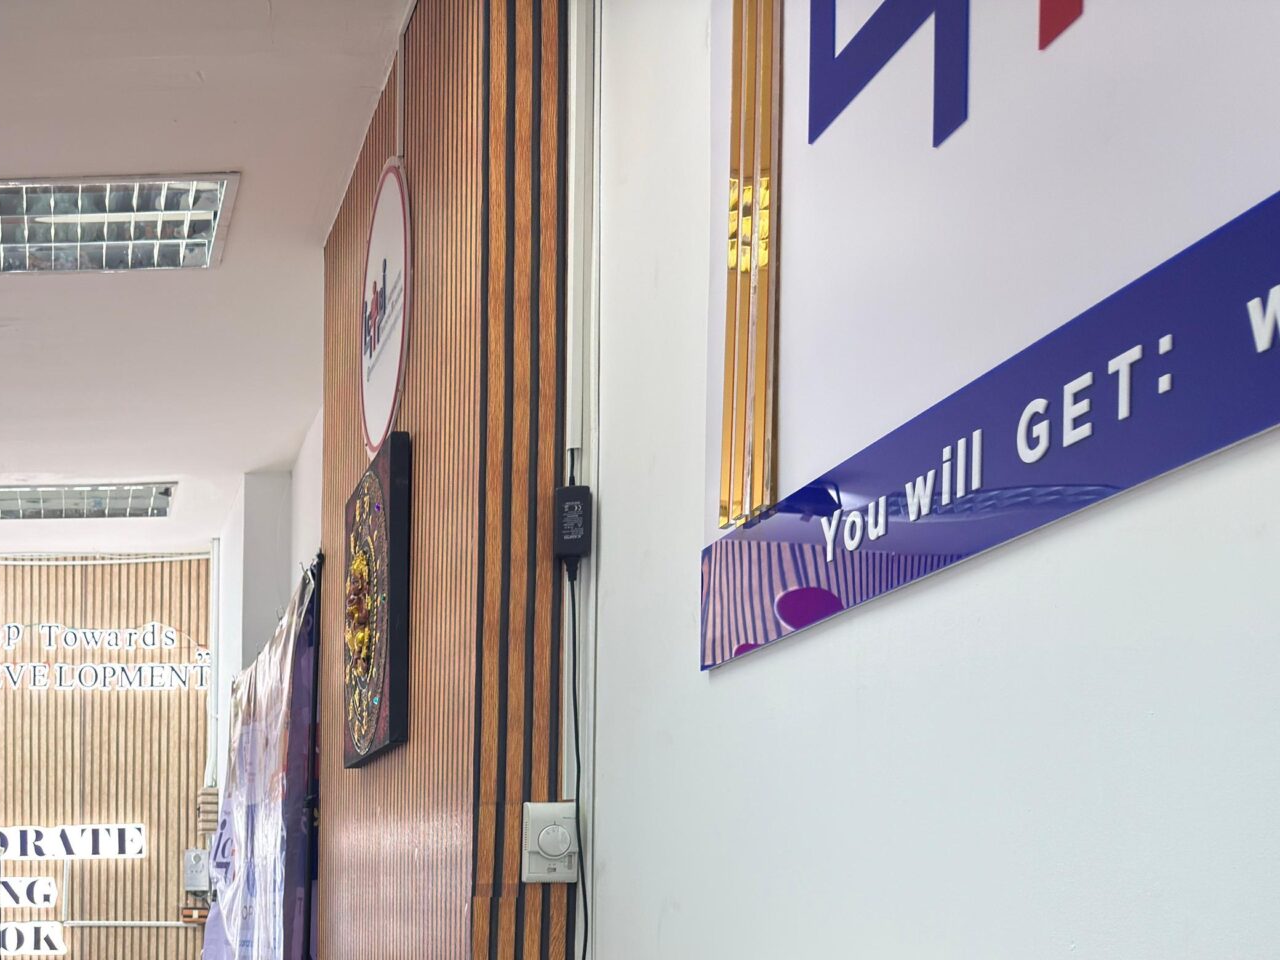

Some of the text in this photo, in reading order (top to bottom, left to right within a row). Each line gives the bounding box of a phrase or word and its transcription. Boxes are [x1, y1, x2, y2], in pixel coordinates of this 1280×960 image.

[819, 495, 888, 562] You
[904, 429, 982, 523] will
[1016, 334, 1174, 464] GET:
[41, 621, 176, 648] Towards
[0, 879, 53, 905] NG
[0, 926, 58, 951] OK
